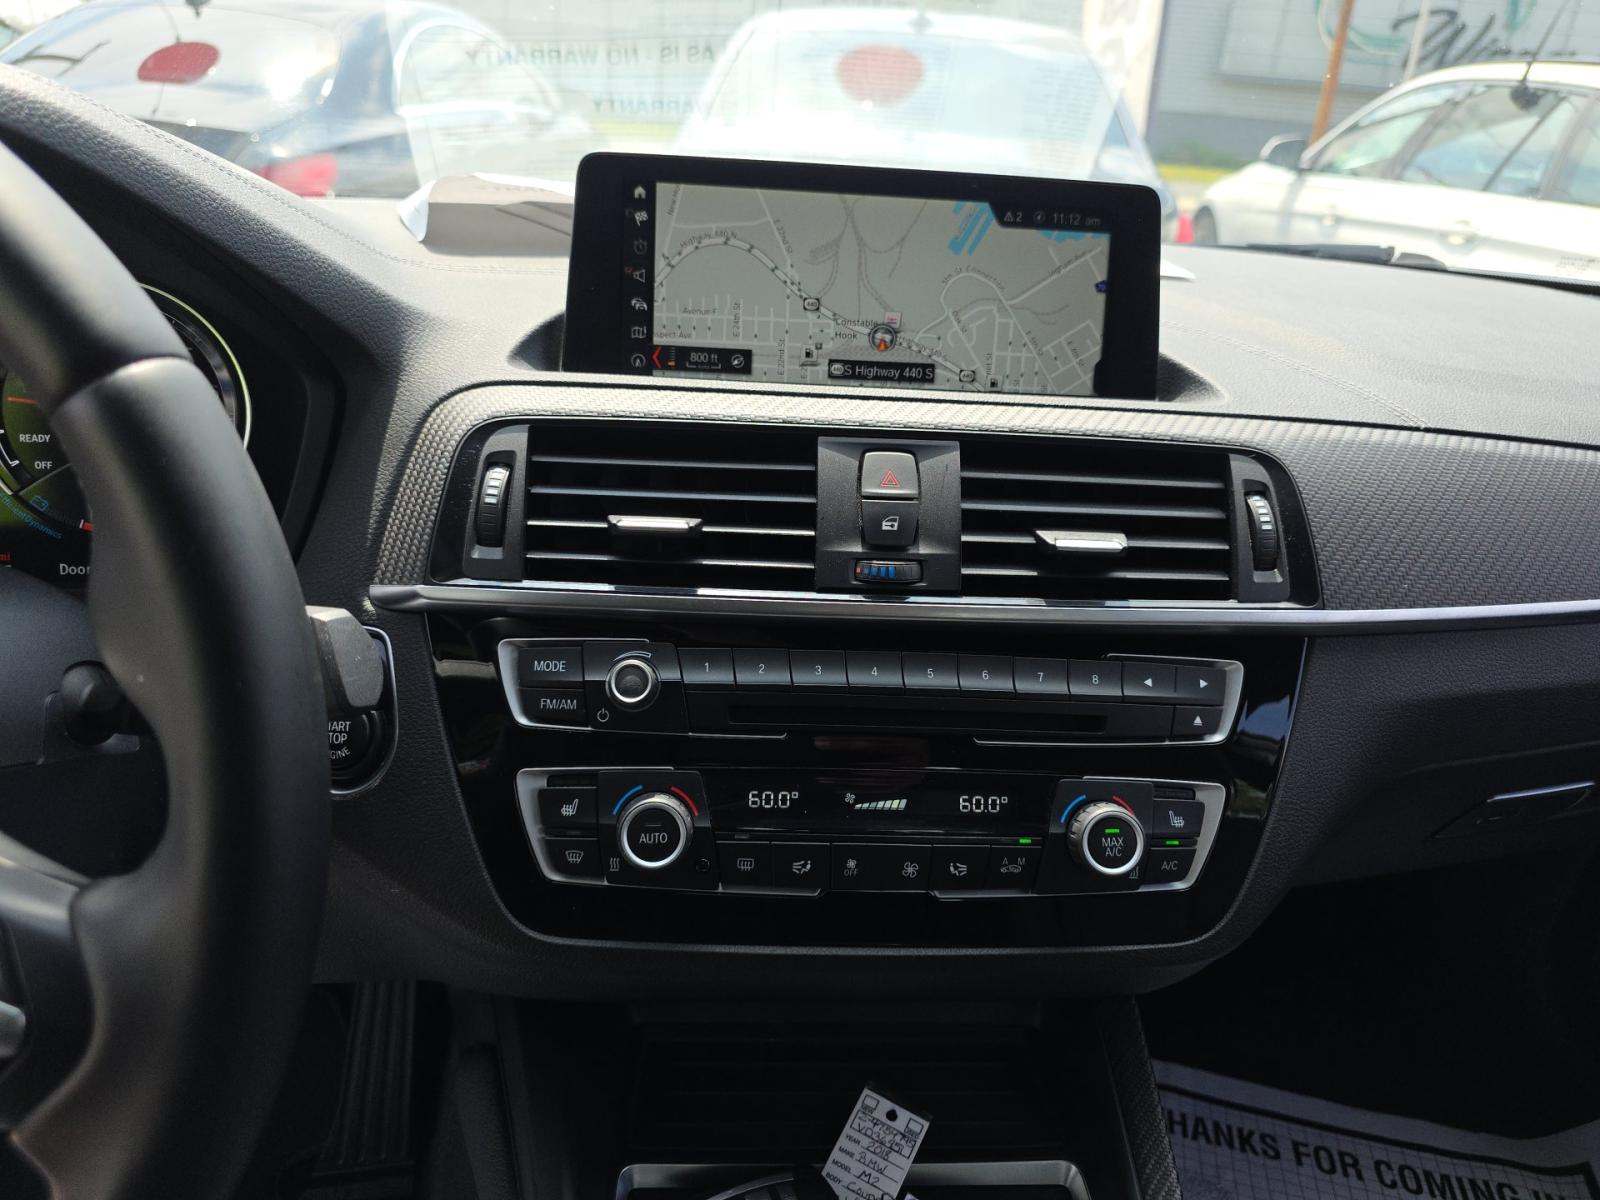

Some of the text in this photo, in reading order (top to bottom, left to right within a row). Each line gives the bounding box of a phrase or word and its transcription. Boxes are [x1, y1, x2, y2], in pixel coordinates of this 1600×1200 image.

[835, 318, 878, 329] Constable
[834, 330, 858, 341] Hook
[690, 352, 719, 363] 800 ft
[855, 365, 901, 380] Highway
[903, 367, 923, 379] 440
[925, 369, 934, 380] S
[19, 433, 51, 443] READY
[34, 461, 53, 470] OFF
[533, 660, 567, 673] MODE
[704, 662, 1099, 685] 1 2 3 4 5 6 7 8
[540, 698, 577, 711] FM/AM
[328, 732, 348, 744] TOP
[330, 747, 351, 760] GINE
[639, 832, 668, 844] AUTO
[1101, 837, 1124, 847] MAX
[1105, 847, 1123, 858] A/C
[1002, 857, 1026, 866] A M
[1161, 860, 1178, 872] A/C
[866, 1142, 893, 1161] 2018
[1166, 1109, 1282, 1161] HANKS
[1291, 1140, 1365, 1182] FOR
[859, 1151, 889, 1173] BMW
[859, 1170, 881, 1186] M2
